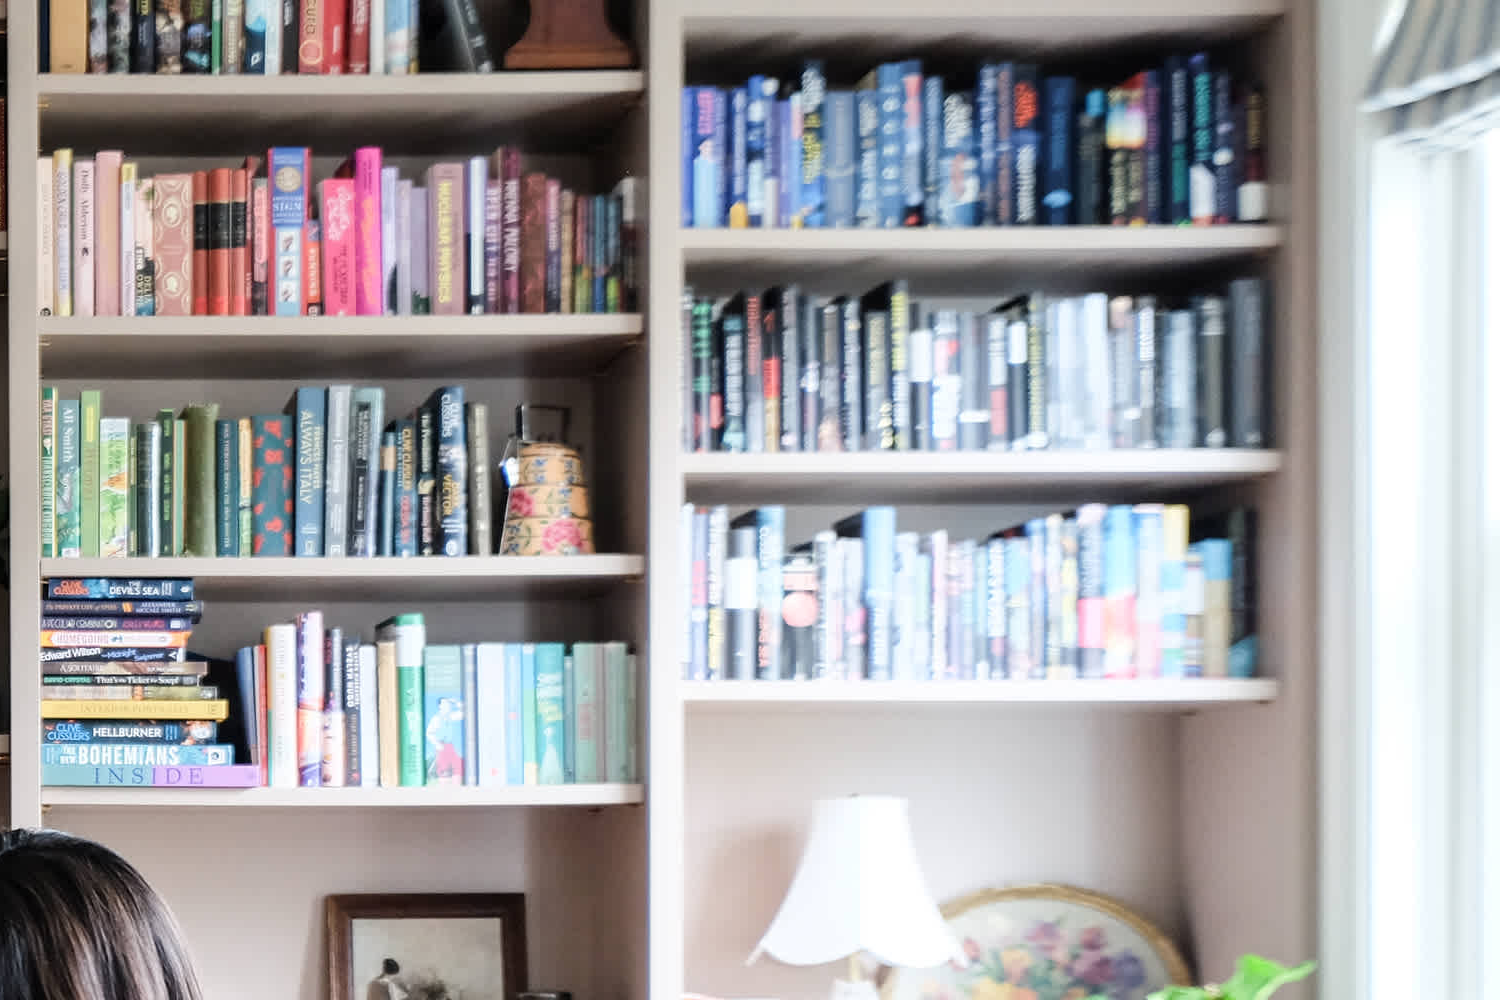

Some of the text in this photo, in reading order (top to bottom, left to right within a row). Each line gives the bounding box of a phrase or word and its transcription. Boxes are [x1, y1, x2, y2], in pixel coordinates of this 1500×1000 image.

[80, 169, 90, 240] Dolly Alderton
[438, 182, 452, 244] NUCLEAR
[144, 275, 152, 304] DELIA
[62, 407, 75, 464] Ali Smith
[299, 410, 313, 505] ALWAYS ITALY
[442, 474, 452, 515] VECTOR
[142, 587, 160, 596] SEA
[40, 647, 101, 662] Edward Wilson
[346, 647, 354, 680] EVELYN
[346, 682, 355, 708] HUGO
[56, 723, 82, 732] CLIVE
[92, 727, 162, 738] HELLBURNER
[78, 744, 180, 765] BOHEMIANS
[93, 767, 204, 785] INSIDE
